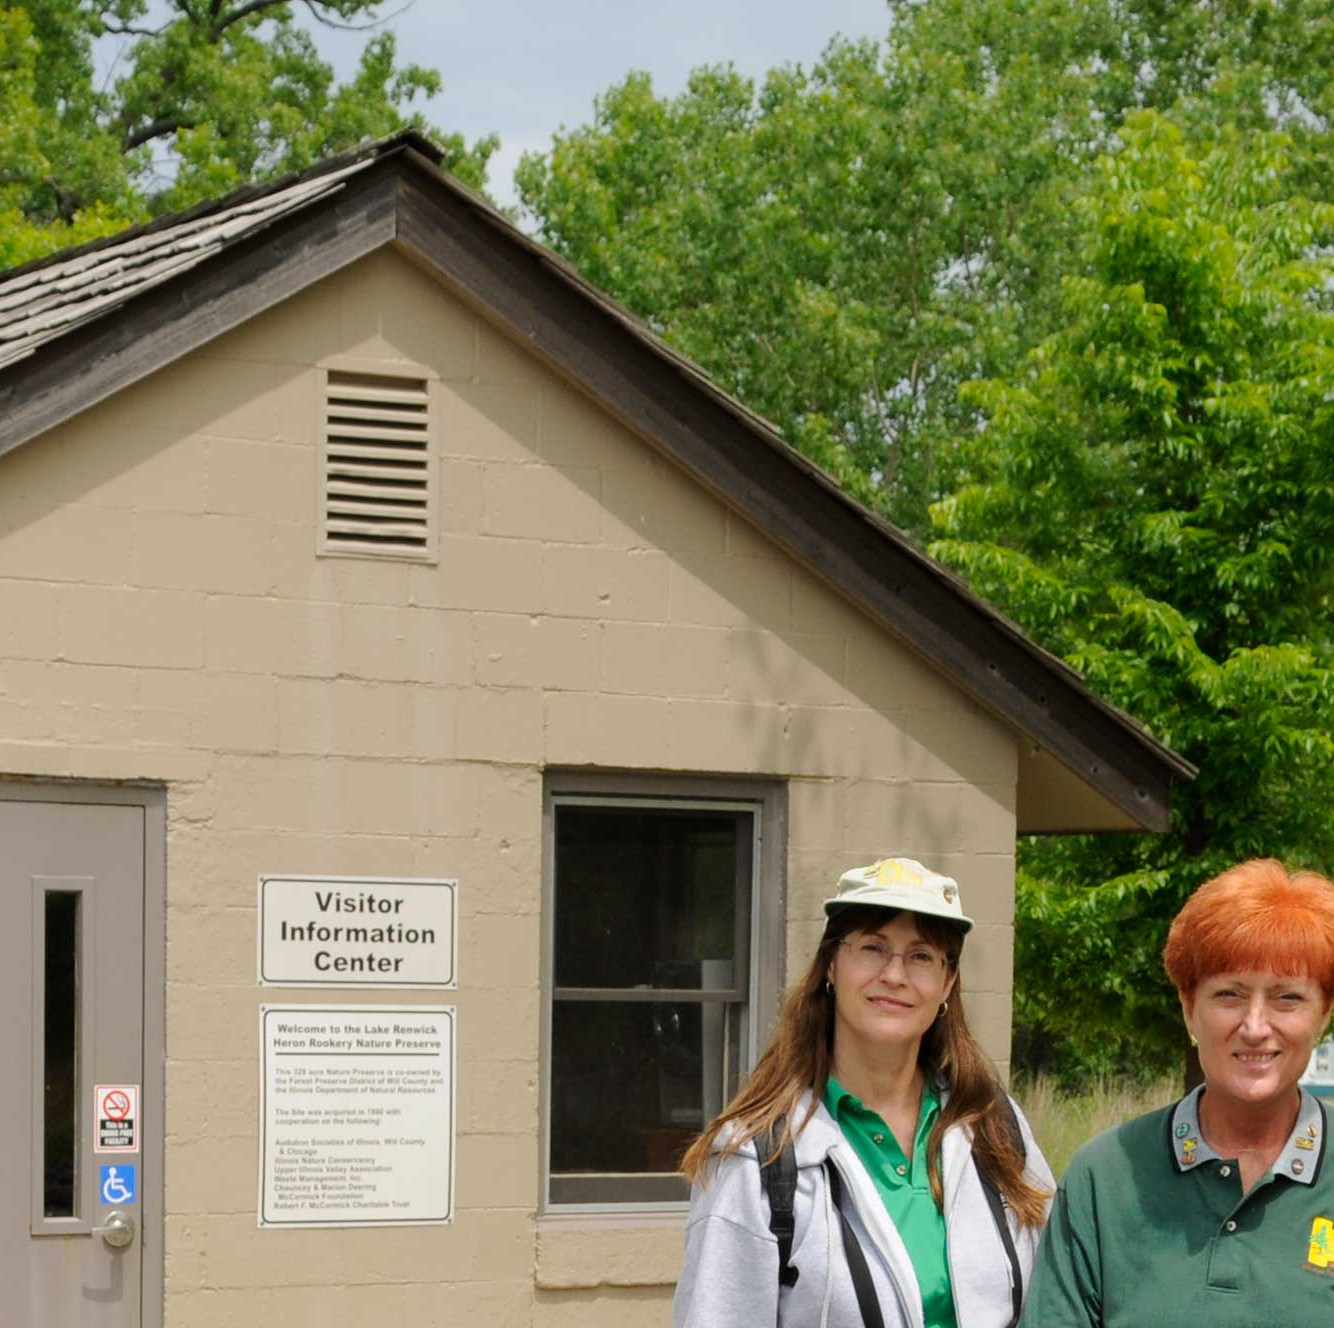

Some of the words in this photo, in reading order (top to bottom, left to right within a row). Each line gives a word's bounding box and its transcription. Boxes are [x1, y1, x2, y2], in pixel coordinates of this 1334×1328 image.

[315, 892, 404, 914] Visitor
[281, 921, 435, 944] Information
[315, 952, 404, 972] Center
[278, 1024, 326, 1034] Welcome
[330, 1025, 340, 1034] to
[344, 1025, 361, 1034] the
[365, 1025, 389, 1034] Lake
[393, 1025, 437, 1034] Renwick
[274, 1039, 305, 1048] Heron
[309, 1039, 352, 1050] Rookery
[356, 1039, 391, 1048] Nature
[396, 1039, 441, 1048] Preserve
